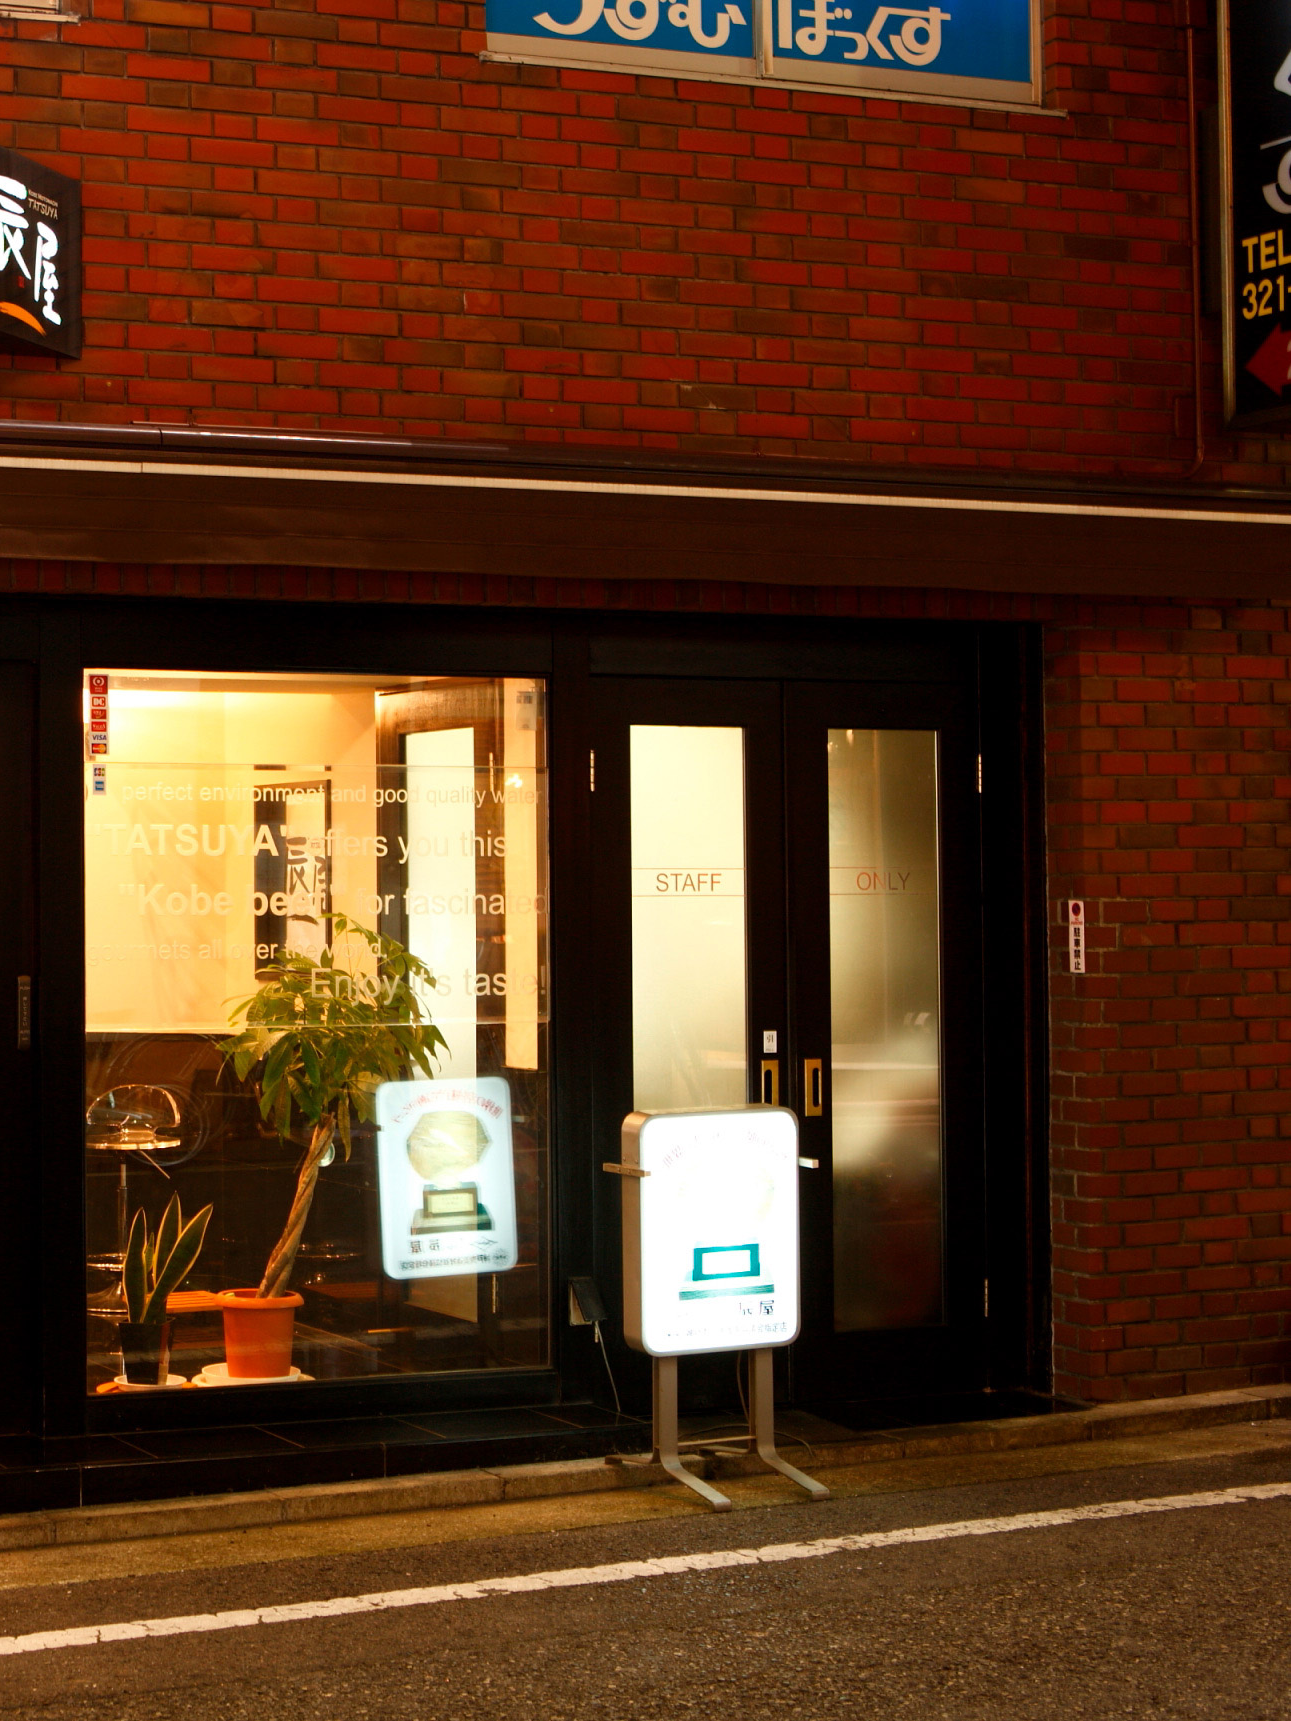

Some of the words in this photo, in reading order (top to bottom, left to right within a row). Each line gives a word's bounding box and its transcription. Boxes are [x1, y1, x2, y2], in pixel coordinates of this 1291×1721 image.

[28, 198, 58, 220] TATSUYA
[1241, 229, 1291, 274] TEL
[122, 782, 193, 804] perfect
[200, 783, 325, 802] environment
[332, 785, 366, 802] and
[373, 785, 418, 807] good
[427, 786, 486, 808] quality
[397, 835, 449, 864] you
[460, 830, 510, 857] this
[656, 873, 723, 892] STAFF
[856, 872, 911, 891] ONLY
[359, 887, 395, 915] for
[403, 887, 550, 916] fascinated
[199, 939, 223, 960] all
[230, 943, 278, 960] over
[311, 968, 401, 1006] Enjoy
